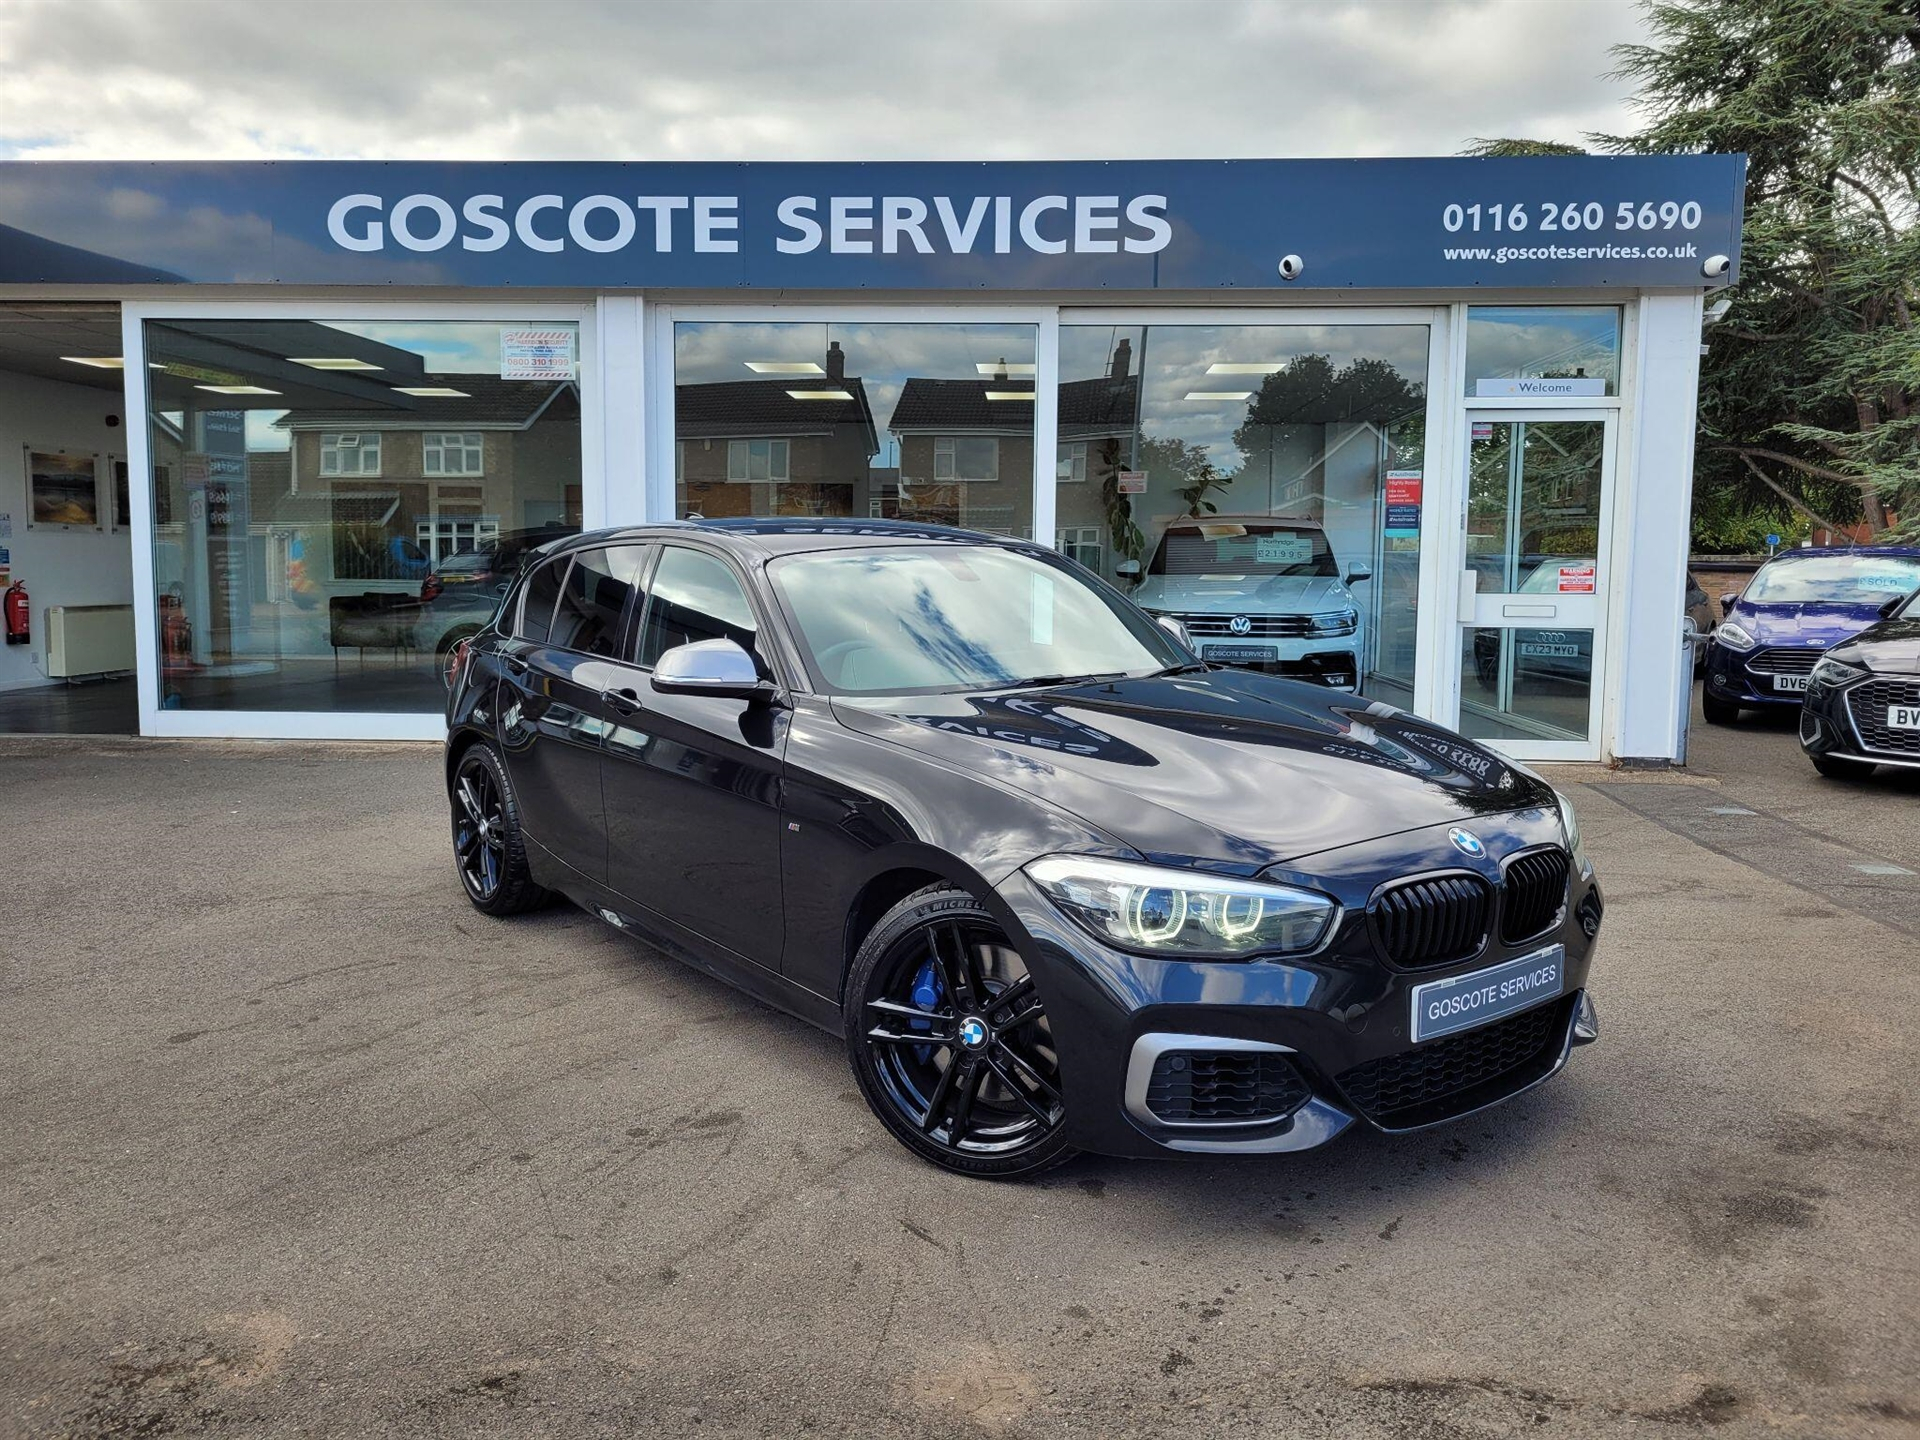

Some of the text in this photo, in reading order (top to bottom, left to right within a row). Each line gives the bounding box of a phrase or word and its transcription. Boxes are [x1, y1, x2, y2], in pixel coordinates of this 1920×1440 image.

[327, 194, 1172, 254] GOSCOTE SERVICES
[1443, 201, 1702, 232] 0116 260 5690
[1443, 242, 1697, 264] www.goscoteservices.co.uk
[508, 358, 569, 366] 0800 310 1999
[1518, 382, 1573, 393] Welcome
[1240, 650, 1273, 658] SERVICES
[1525, 644, 1552, 655] CX23
[1428, 964, 1556, 1020] GOSCOTE SERVICES
